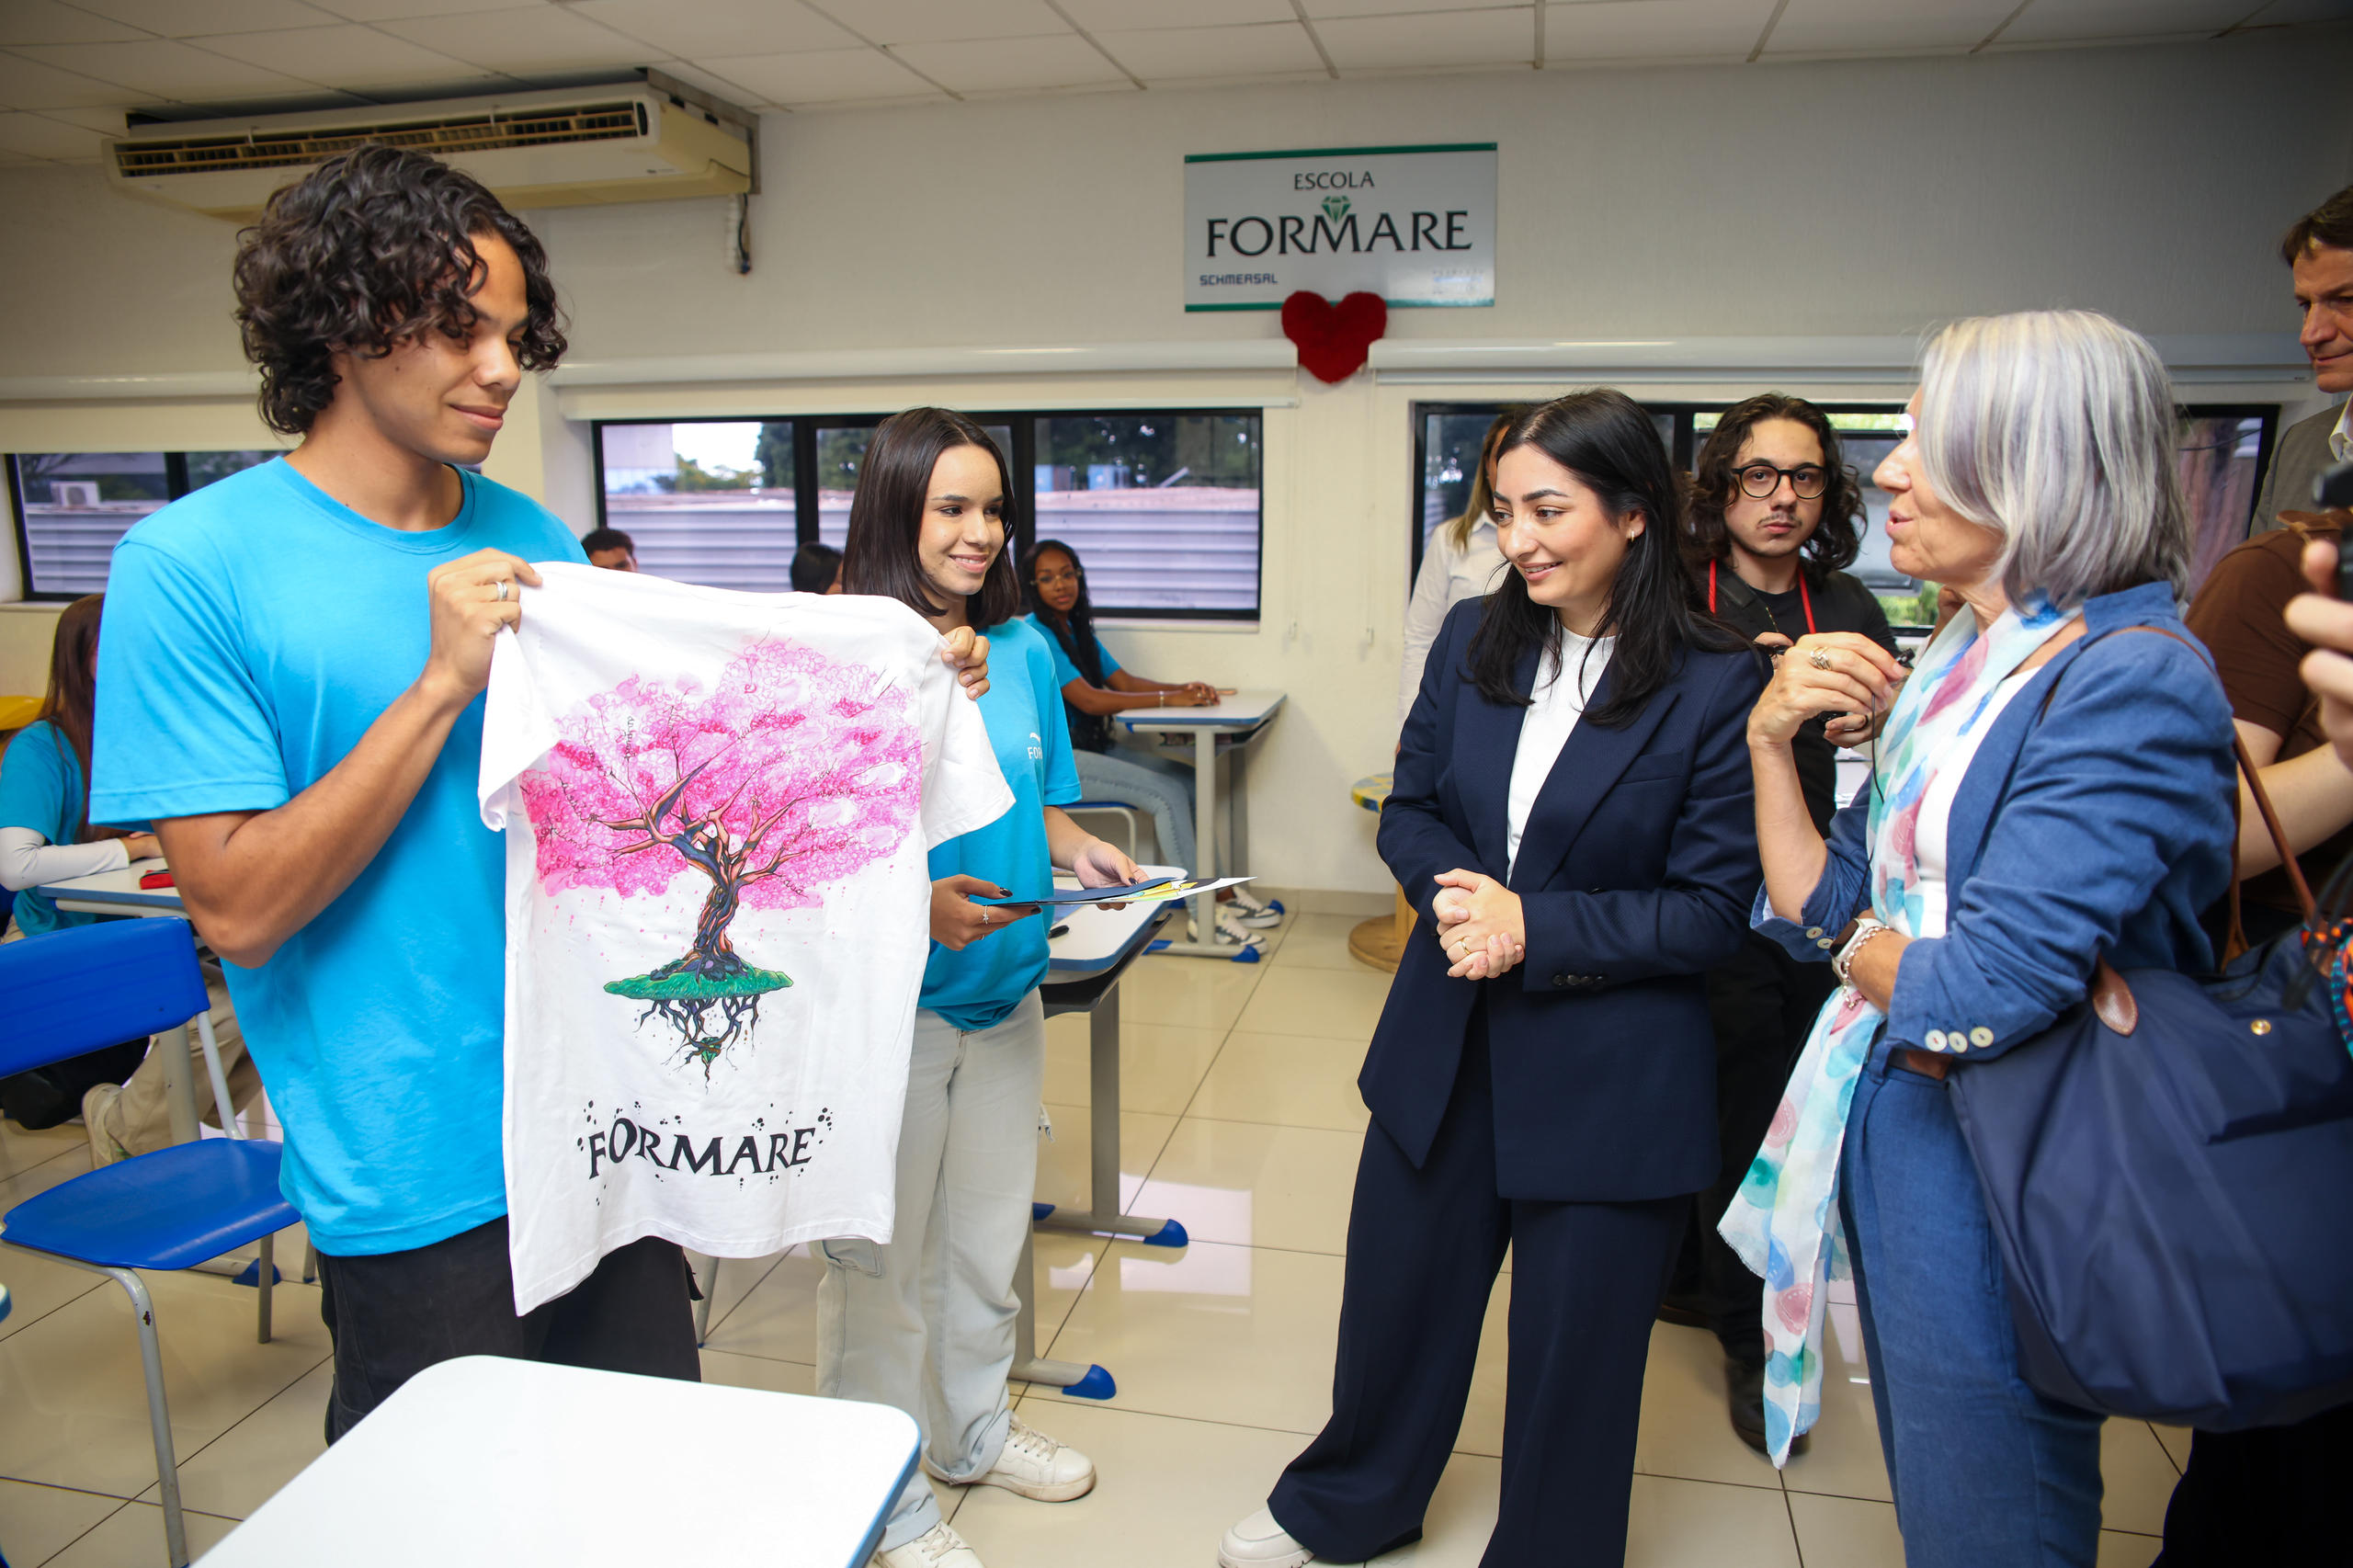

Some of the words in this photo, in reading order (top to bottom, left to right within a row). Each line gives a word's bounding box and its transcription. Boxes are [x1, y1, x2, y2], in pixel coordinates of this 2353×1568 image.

[1294, 171, 1375, 190] ESCOLA
[1207, 210, 1472, 256] FORMARE
[1199, 273, 1279, 286] SCHMERSAL
[588, 1118, 816, 1179] FORMARE
